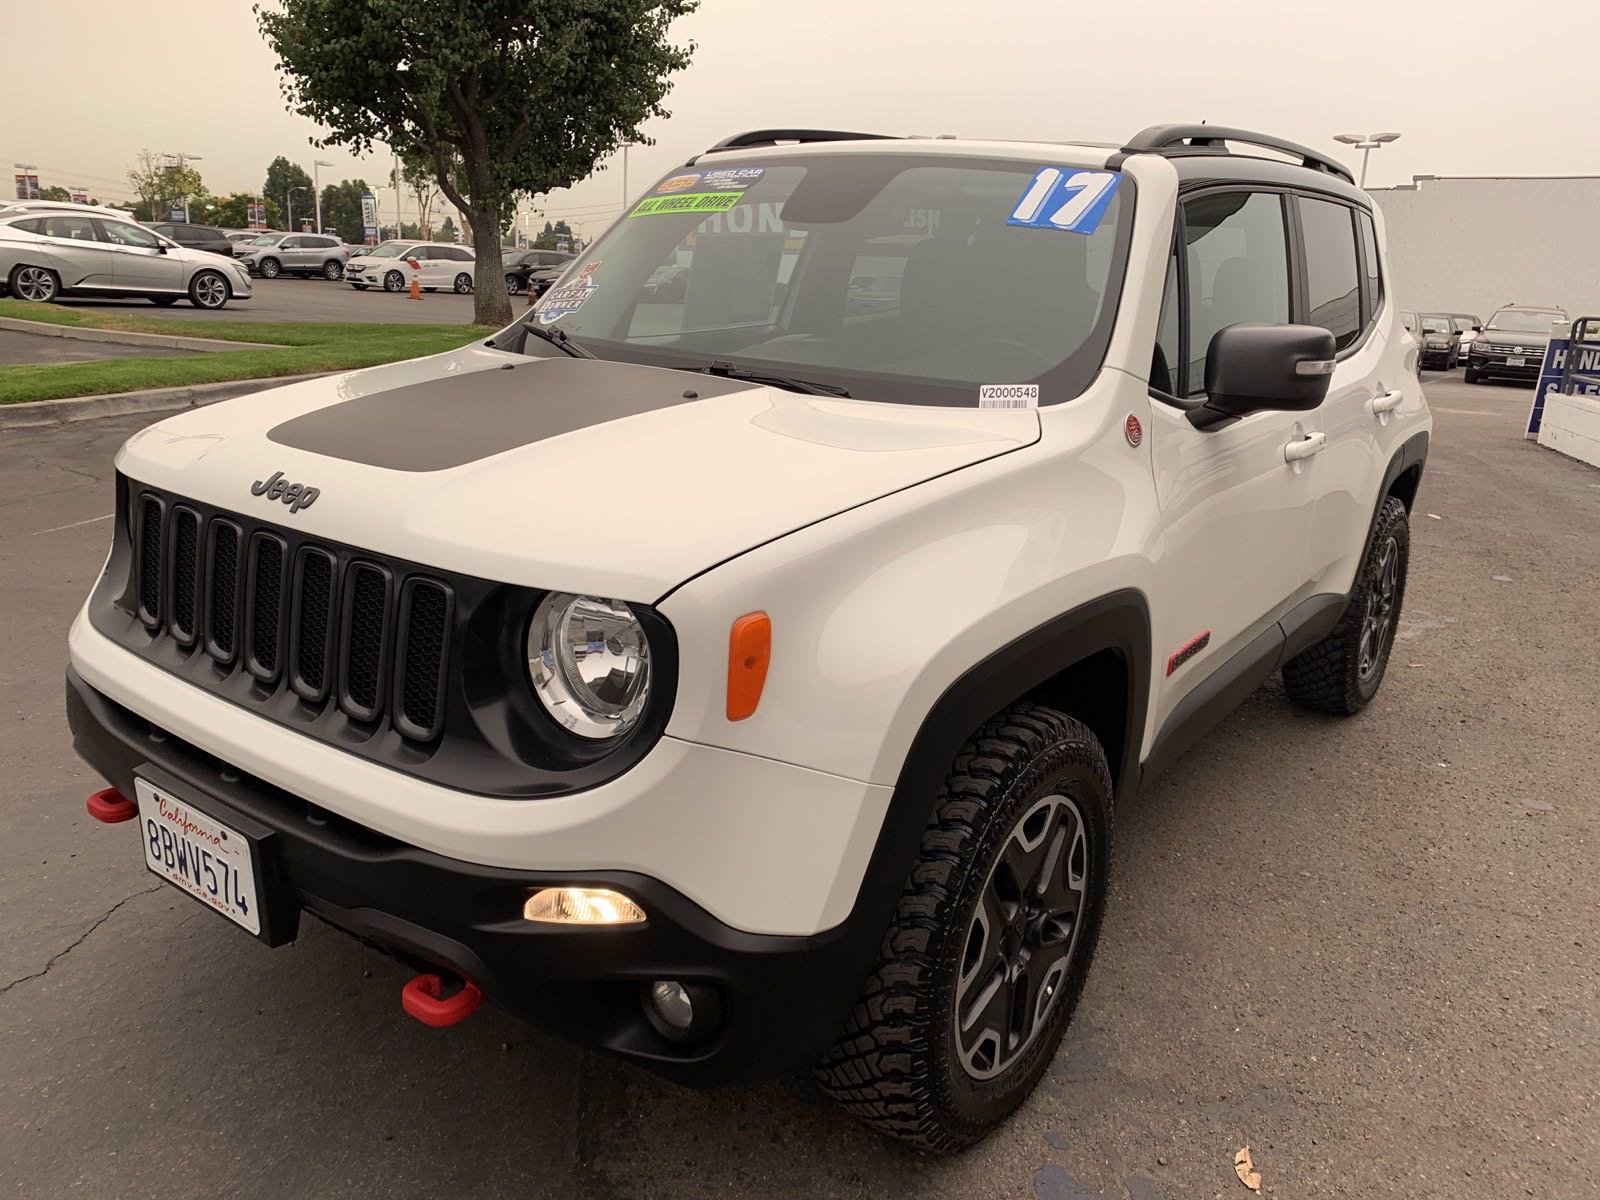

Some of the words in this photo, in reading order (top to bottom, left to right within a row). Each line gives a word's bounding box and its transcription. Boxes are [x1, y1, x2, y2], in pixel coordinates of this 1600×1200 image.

[636, 200, 660, 212] ALL
[656, 197, 699, 210] WHEEL
[695, 195, 738, 208] DRIVE
[1012, 168, 1115, 229] 17
[1552, 349, 1600, 370] HND
[982, 387, 1037, 399] V2000548
[251, 471, 320, 514] Jeep
[159, 799, 226, 853] California
[147, 818, 248, 915] 8BWV574
[173, 873, 230, 912] dmv.ca.gov
